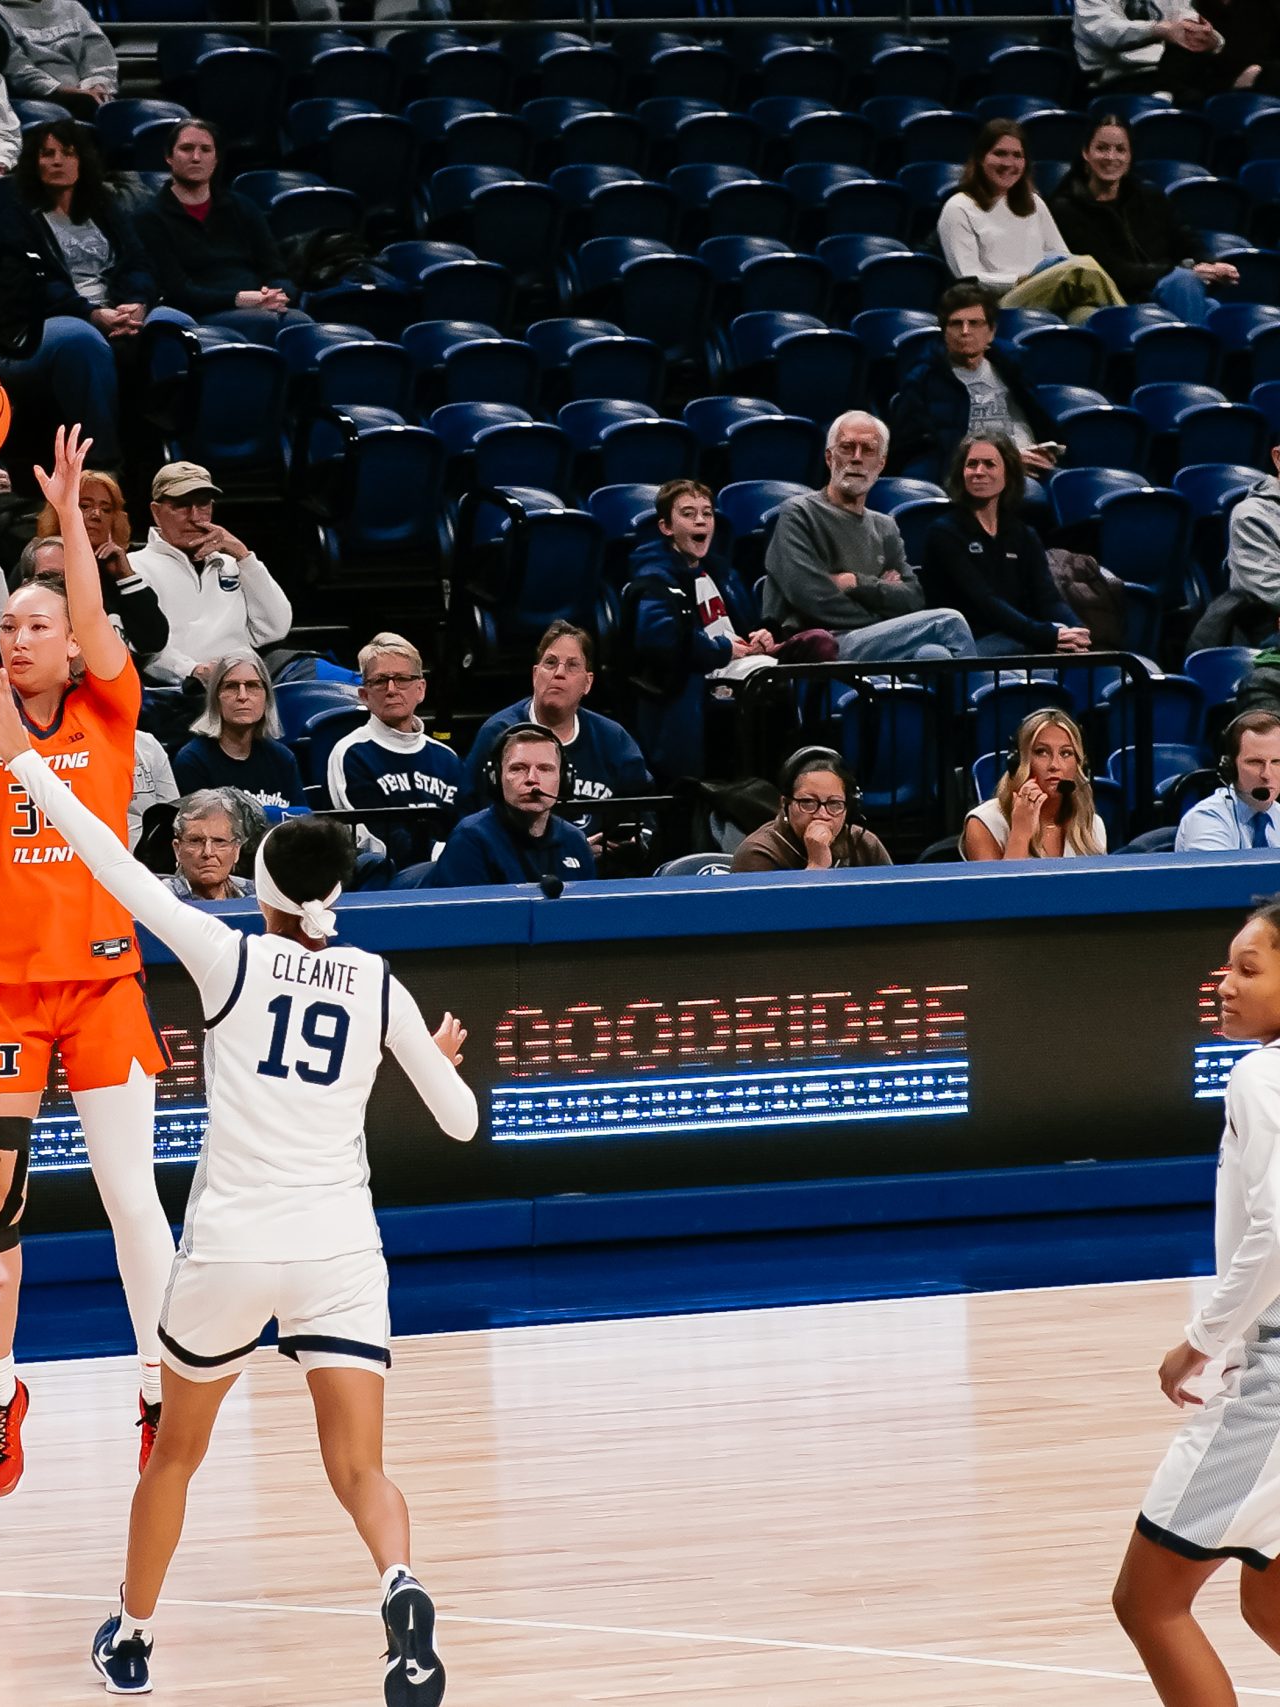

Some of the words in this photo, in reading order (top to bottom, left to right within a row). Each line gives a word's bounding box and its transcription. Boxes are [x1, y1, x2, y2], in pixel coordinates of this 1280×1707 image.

[8, 780, 71, 838] 3
[413, 770, 459, 805] STATE
[12, 846, 75, 864] ILLINI
[272, 952, 359, 996] CLÉANTE
[256, 993, 351, 1087] 19
[495, 984, 969, 1076] GOODRIDGE
